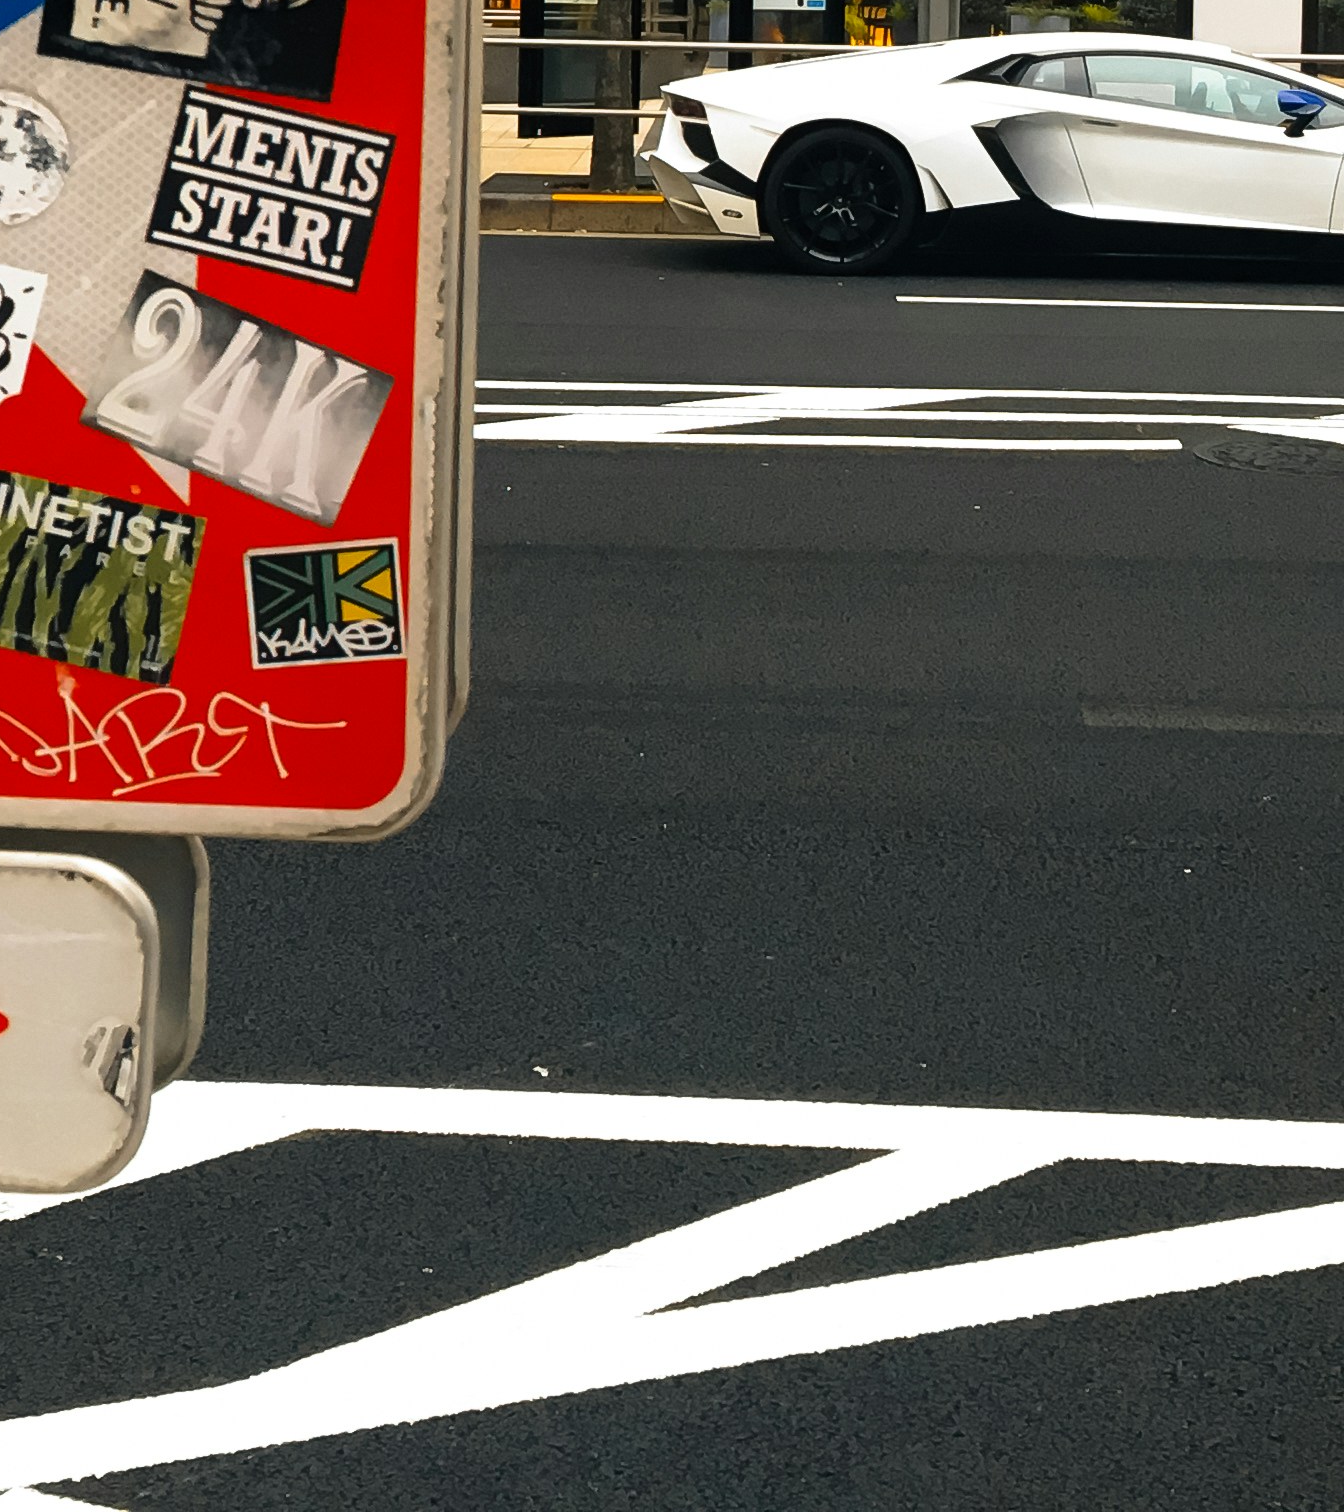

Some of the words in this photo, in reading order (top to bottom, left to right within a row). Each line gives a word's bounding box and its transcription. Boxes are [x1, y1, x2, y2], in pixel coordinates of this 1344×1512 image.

[174, 104, 385, 202] MENIS
[172, 180, 353, 270] STAR!
[97, 288, 368, 516] 24K
